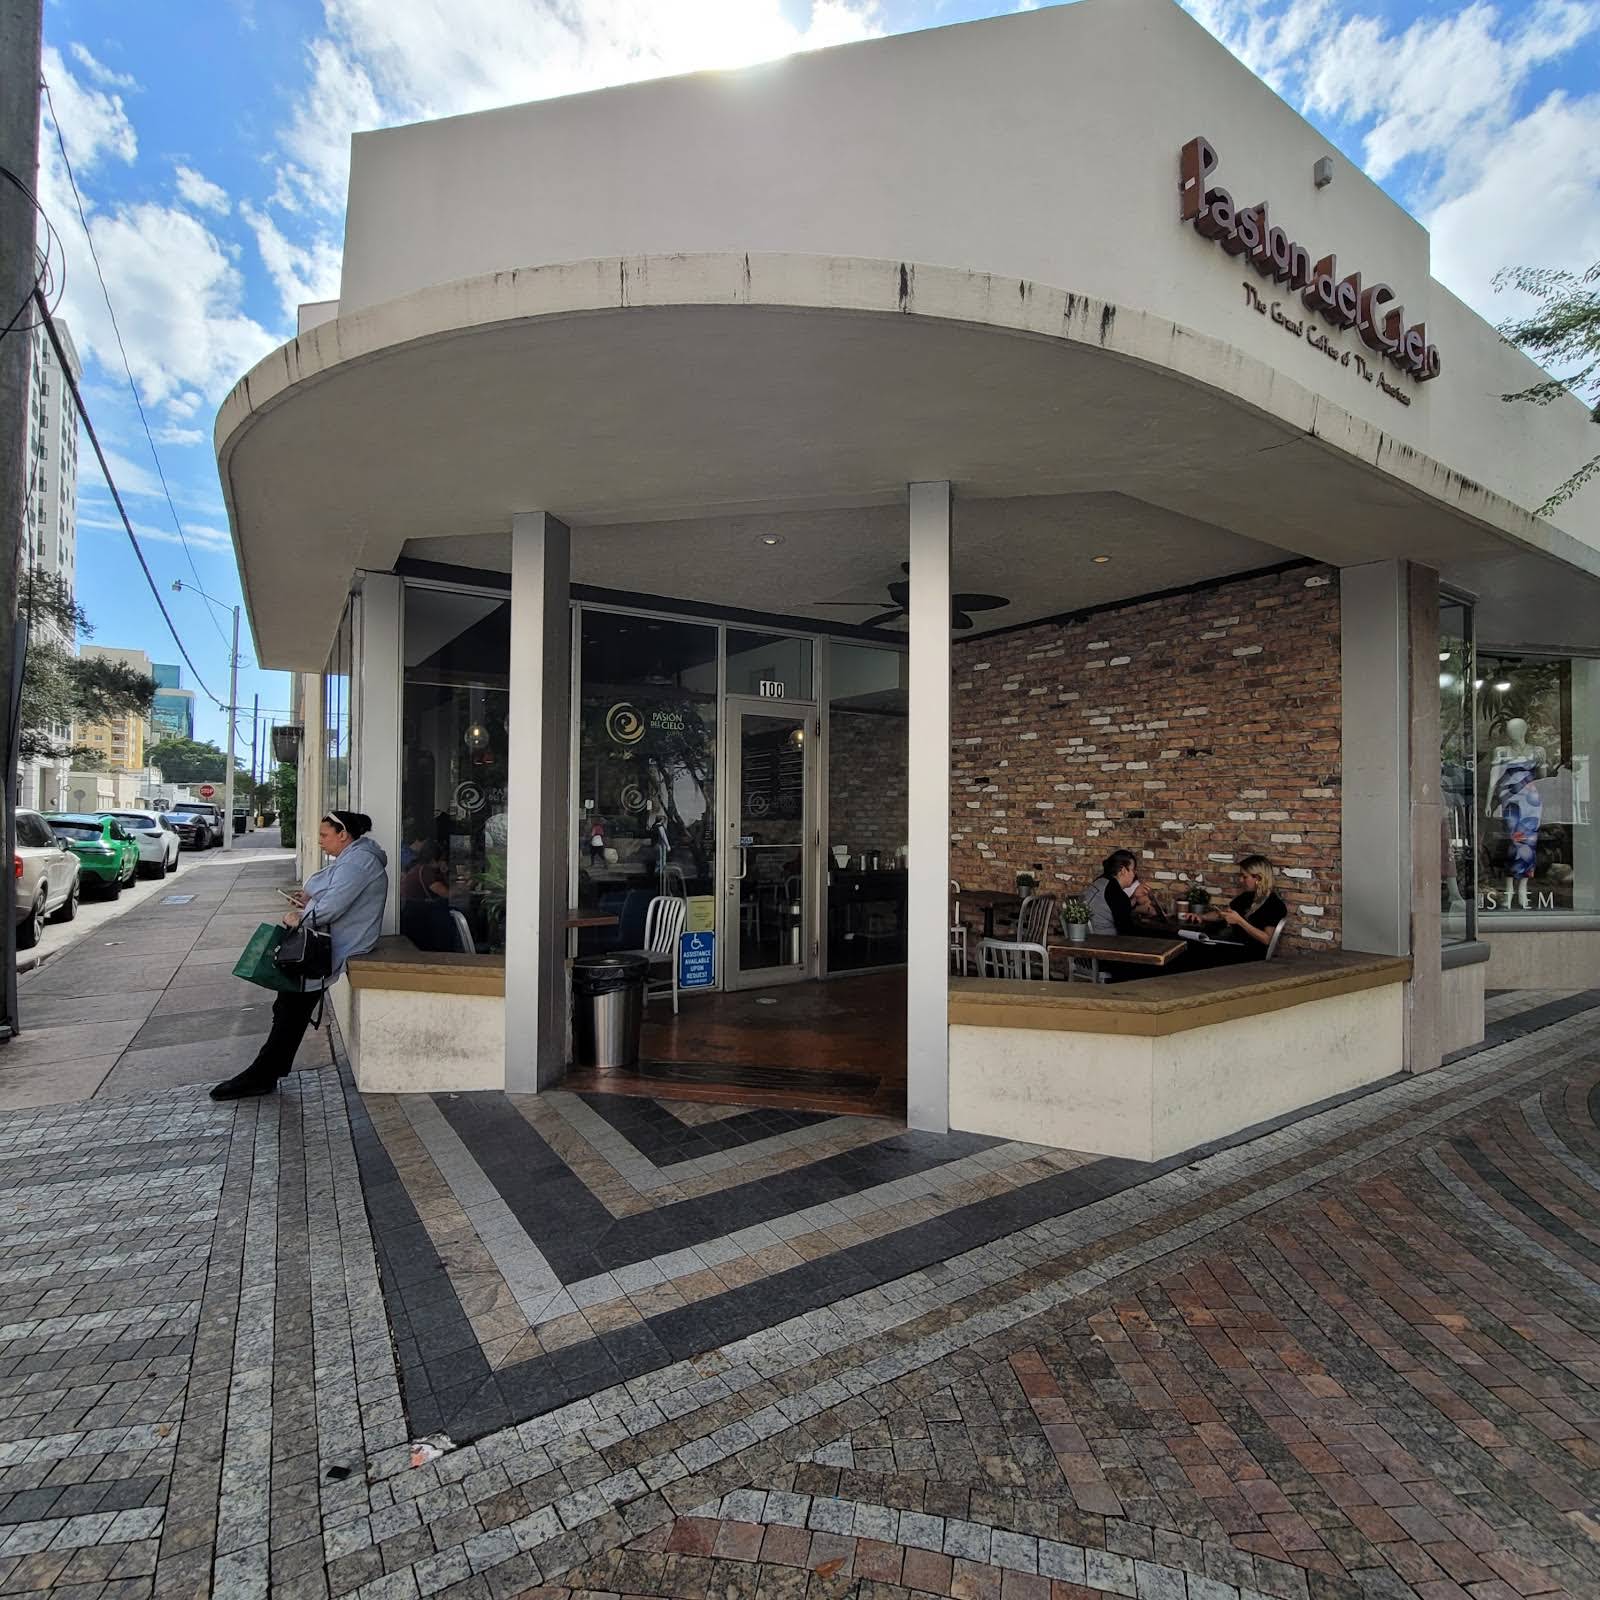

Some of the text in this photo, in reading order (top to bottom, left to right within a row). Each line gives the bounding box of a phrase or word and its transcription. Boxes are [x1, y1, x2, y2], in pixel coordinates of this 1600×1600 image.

[1303, 253, 1362, 330] del
[1358, 282, 1441, 383] Cielo
[1242, 282, 1267, 315] The
[1271, 302, 1303, 337] Grand
[1354, 354, 1373, 382] The
[762, 682, 783, 697] 100
[661, 721, 685, 730] CIELO
[685, 957, 710, 965] AVAILABLE
[686, 971, 708, 979] REQUEST
